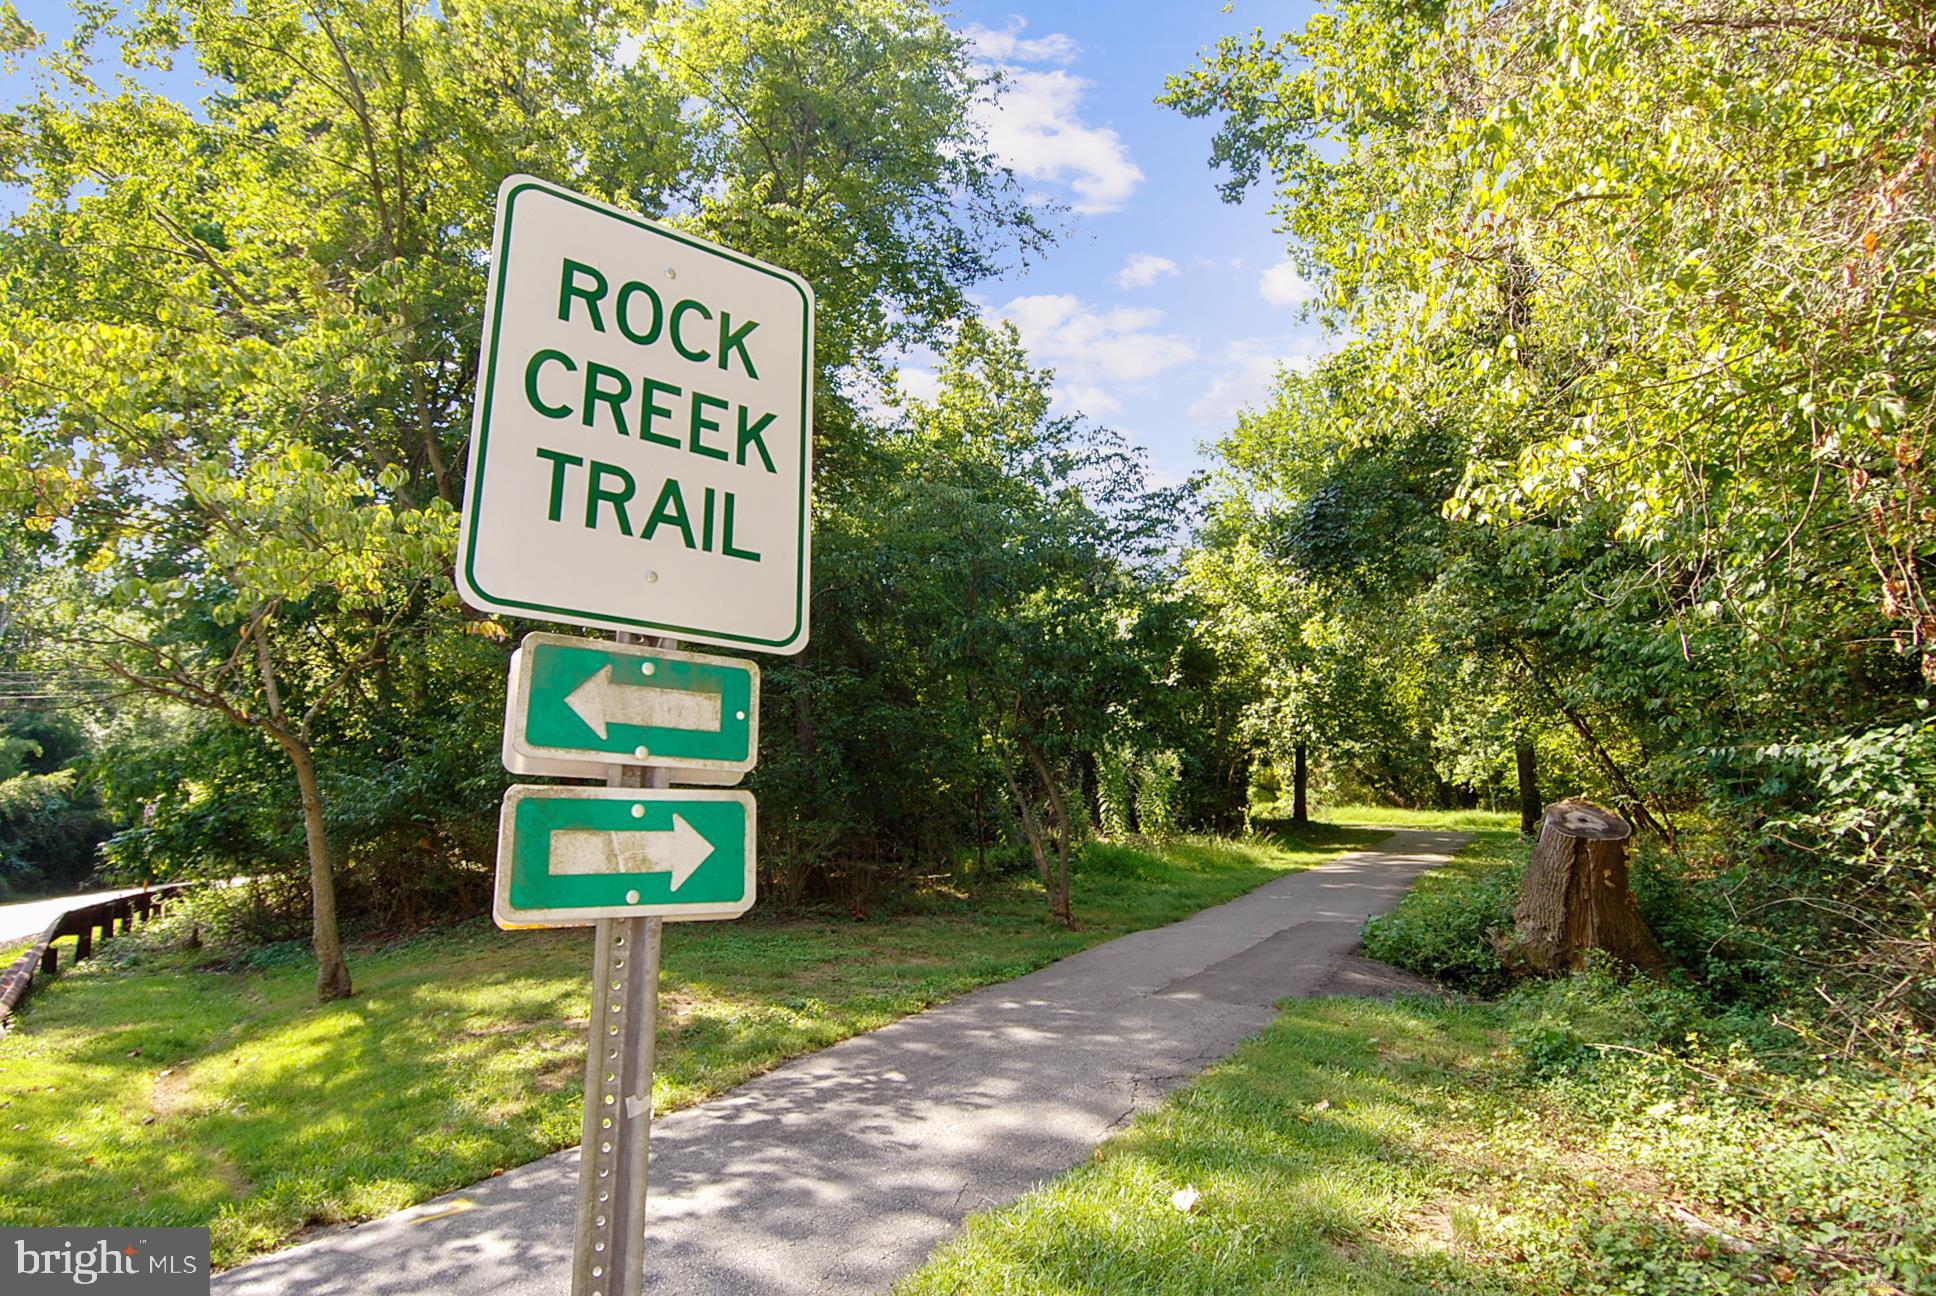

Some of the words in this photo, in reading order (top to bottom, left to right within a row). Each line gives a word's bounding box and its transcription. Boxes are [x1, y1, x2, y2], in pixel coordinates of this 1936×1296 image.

[557, 257, 761, 381] ROCK
[524, 348, 778, 474] CREEK
[536, 447, 762, 563] TRAIL
